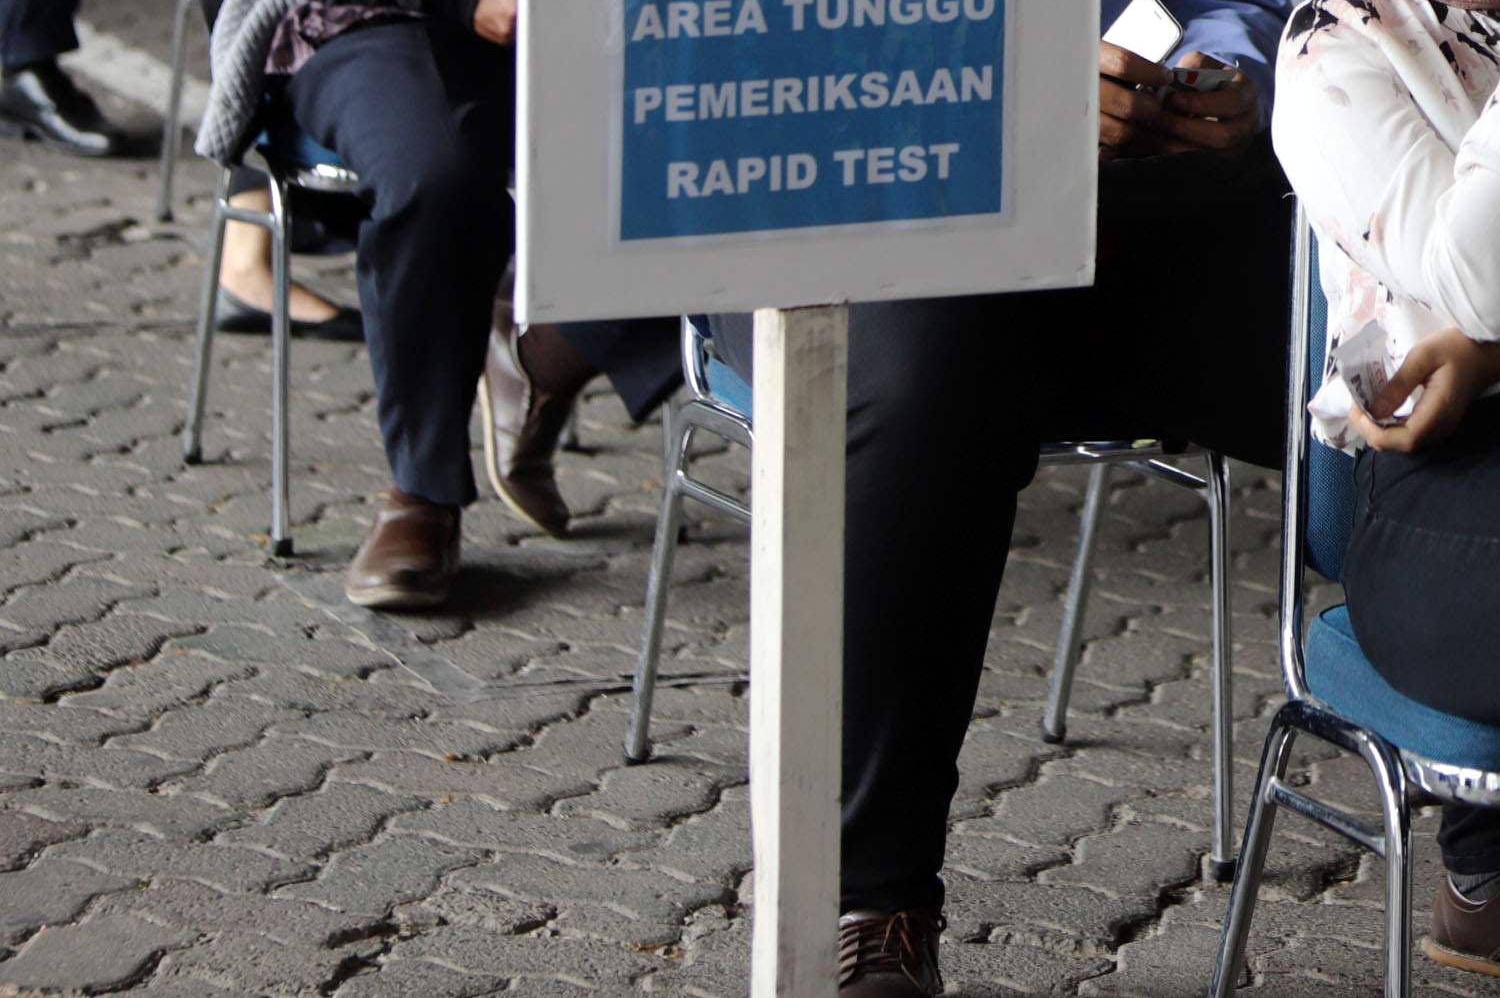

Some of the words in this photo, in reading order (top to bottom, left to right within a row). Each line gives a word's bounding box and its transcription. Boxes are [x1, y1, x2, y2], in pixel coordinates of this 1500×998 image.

[632, 0, 768, 41] AREA
[634, 65, 993, 124] PEMERIKSAAN
[666, 154, 818, 199] RAPID
[833, 143, 960, 186] TEST
